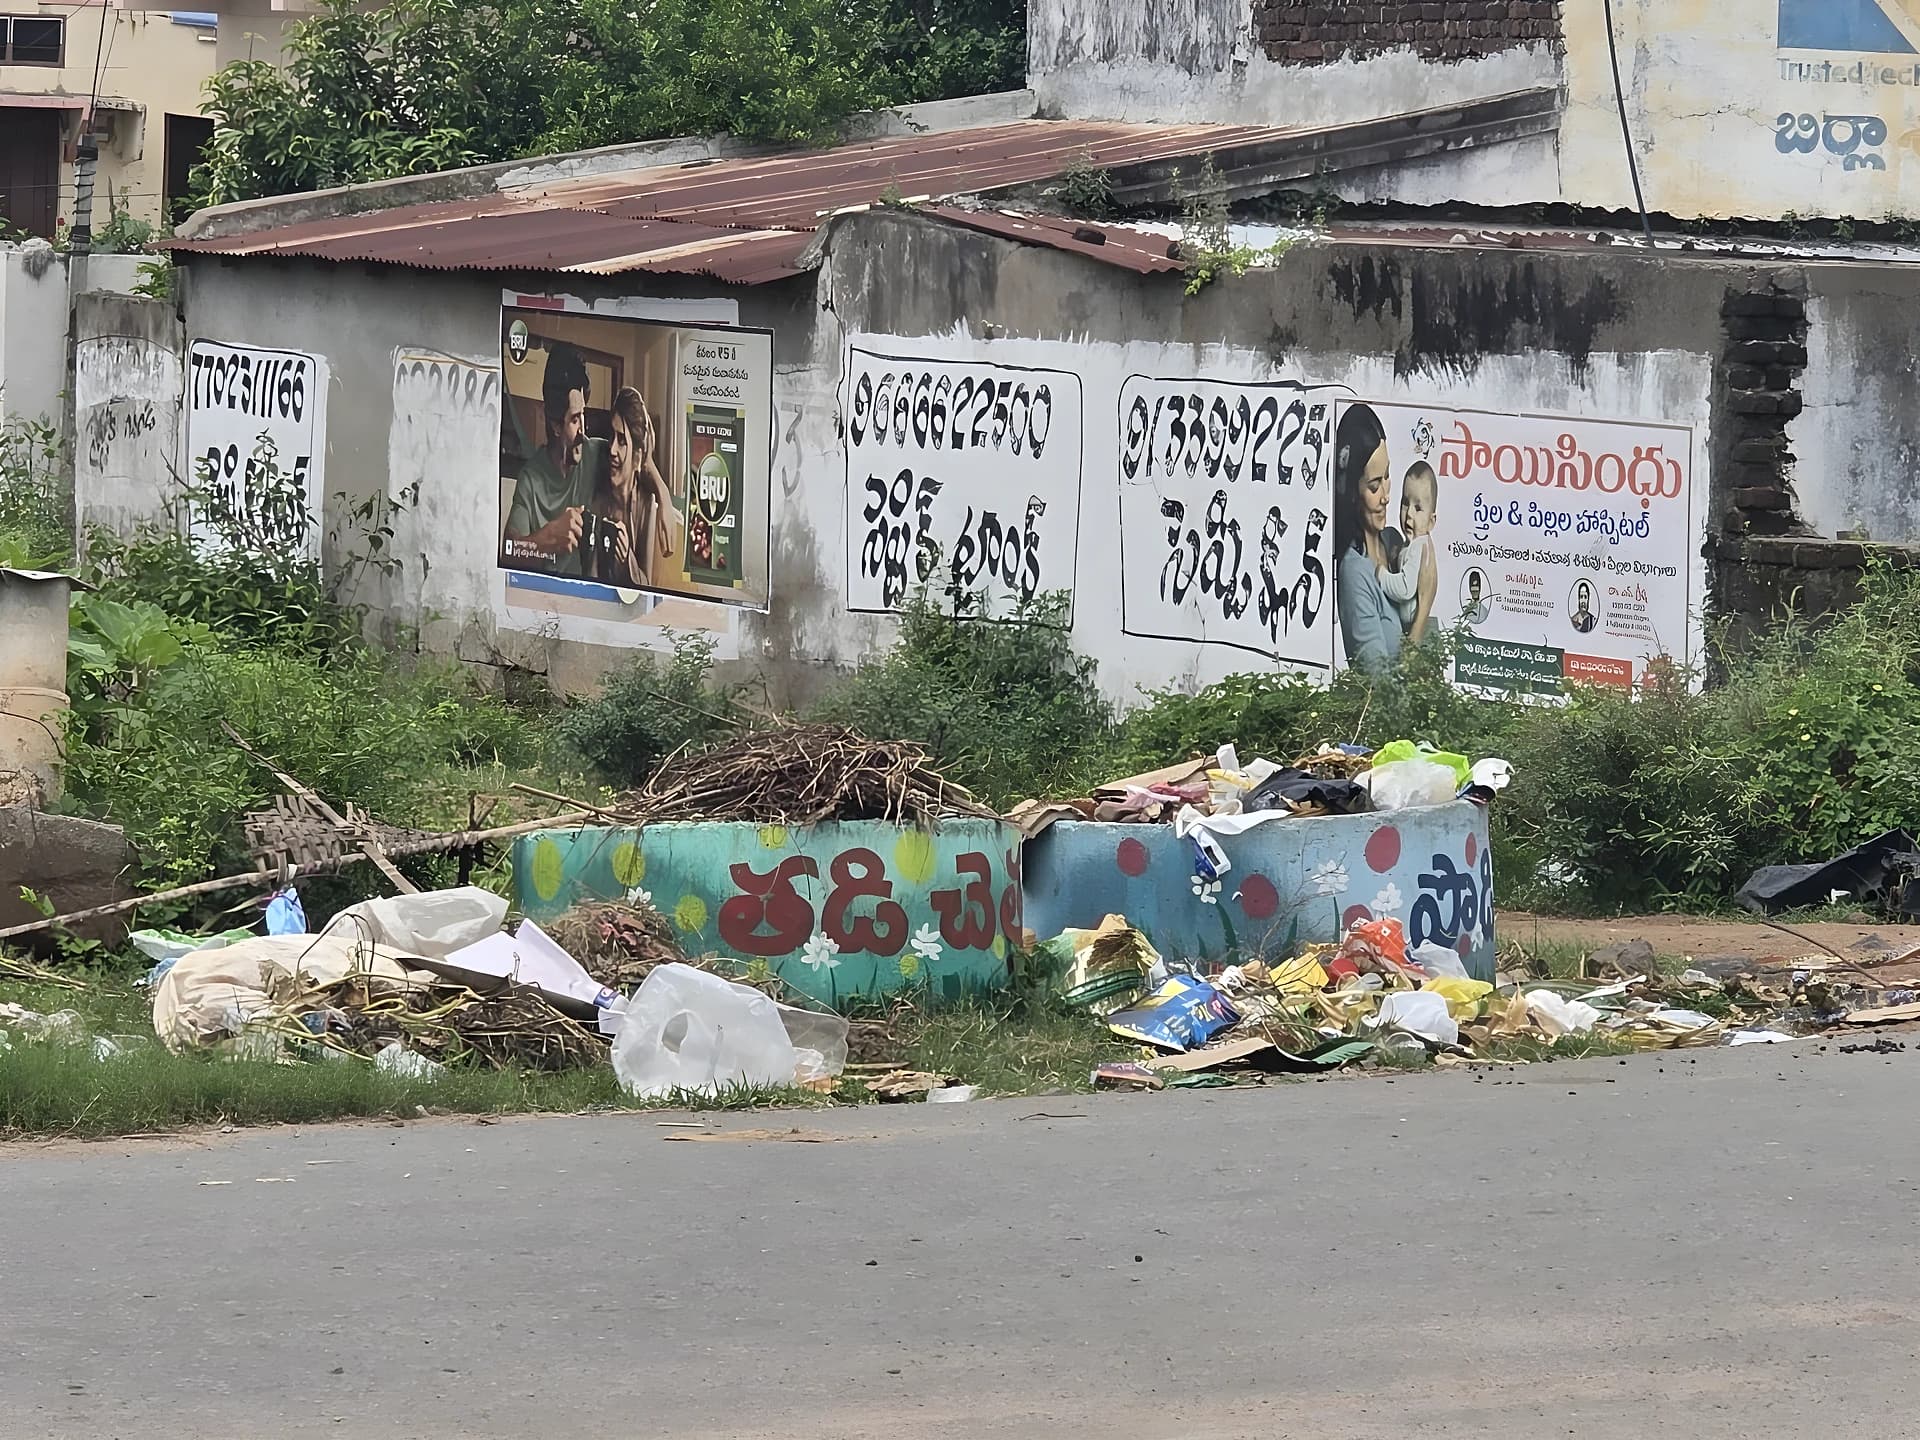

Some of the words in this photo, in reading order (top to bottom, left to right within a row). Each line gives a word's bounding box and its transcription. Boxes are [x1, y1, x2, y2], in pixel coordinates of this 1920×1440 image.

[1776, 58, 1863, 84] Trusted
[510, 334, 527, 350] BRU
[850, 371, 1052, 460] 9666622500
[1122, 393, 1331, 491] 913399225
[700, 475, 727, 503] BRU
[1507, 500, 1524, 527] &
[1528, 501, 1572, 538] పిల్లల
[717, 847, 910, 957] తడి
